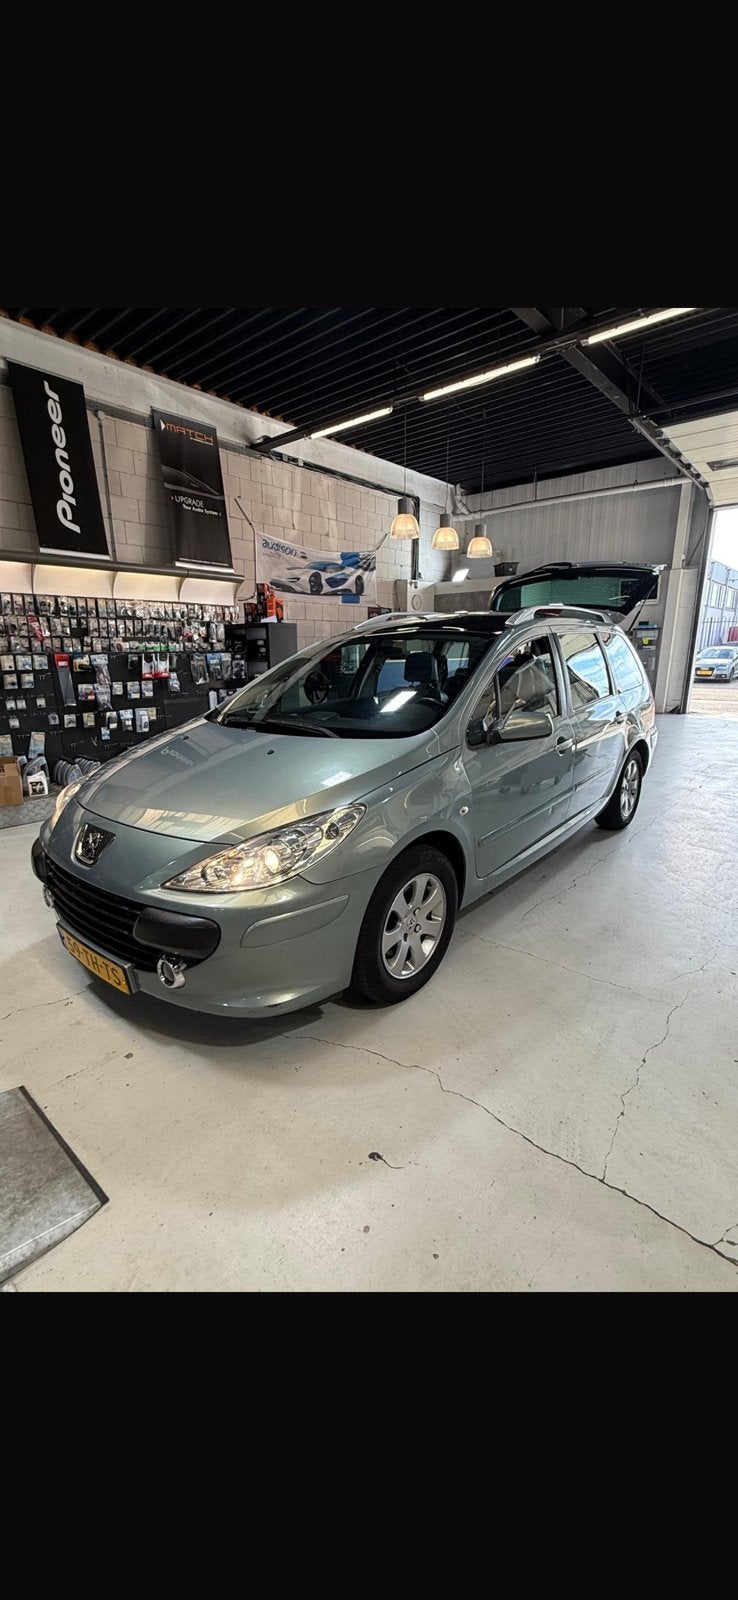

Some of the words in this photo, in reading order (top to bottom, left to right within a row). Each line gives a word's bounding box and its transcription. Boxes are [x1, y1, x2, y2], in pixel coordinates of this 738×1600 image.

[166, 423, 213, 443] MATCH
[43, 380, 81, 534] Pioneer
[174, 495, 204, 507] UPGRADE
[261, 538, 298, 557] audison
